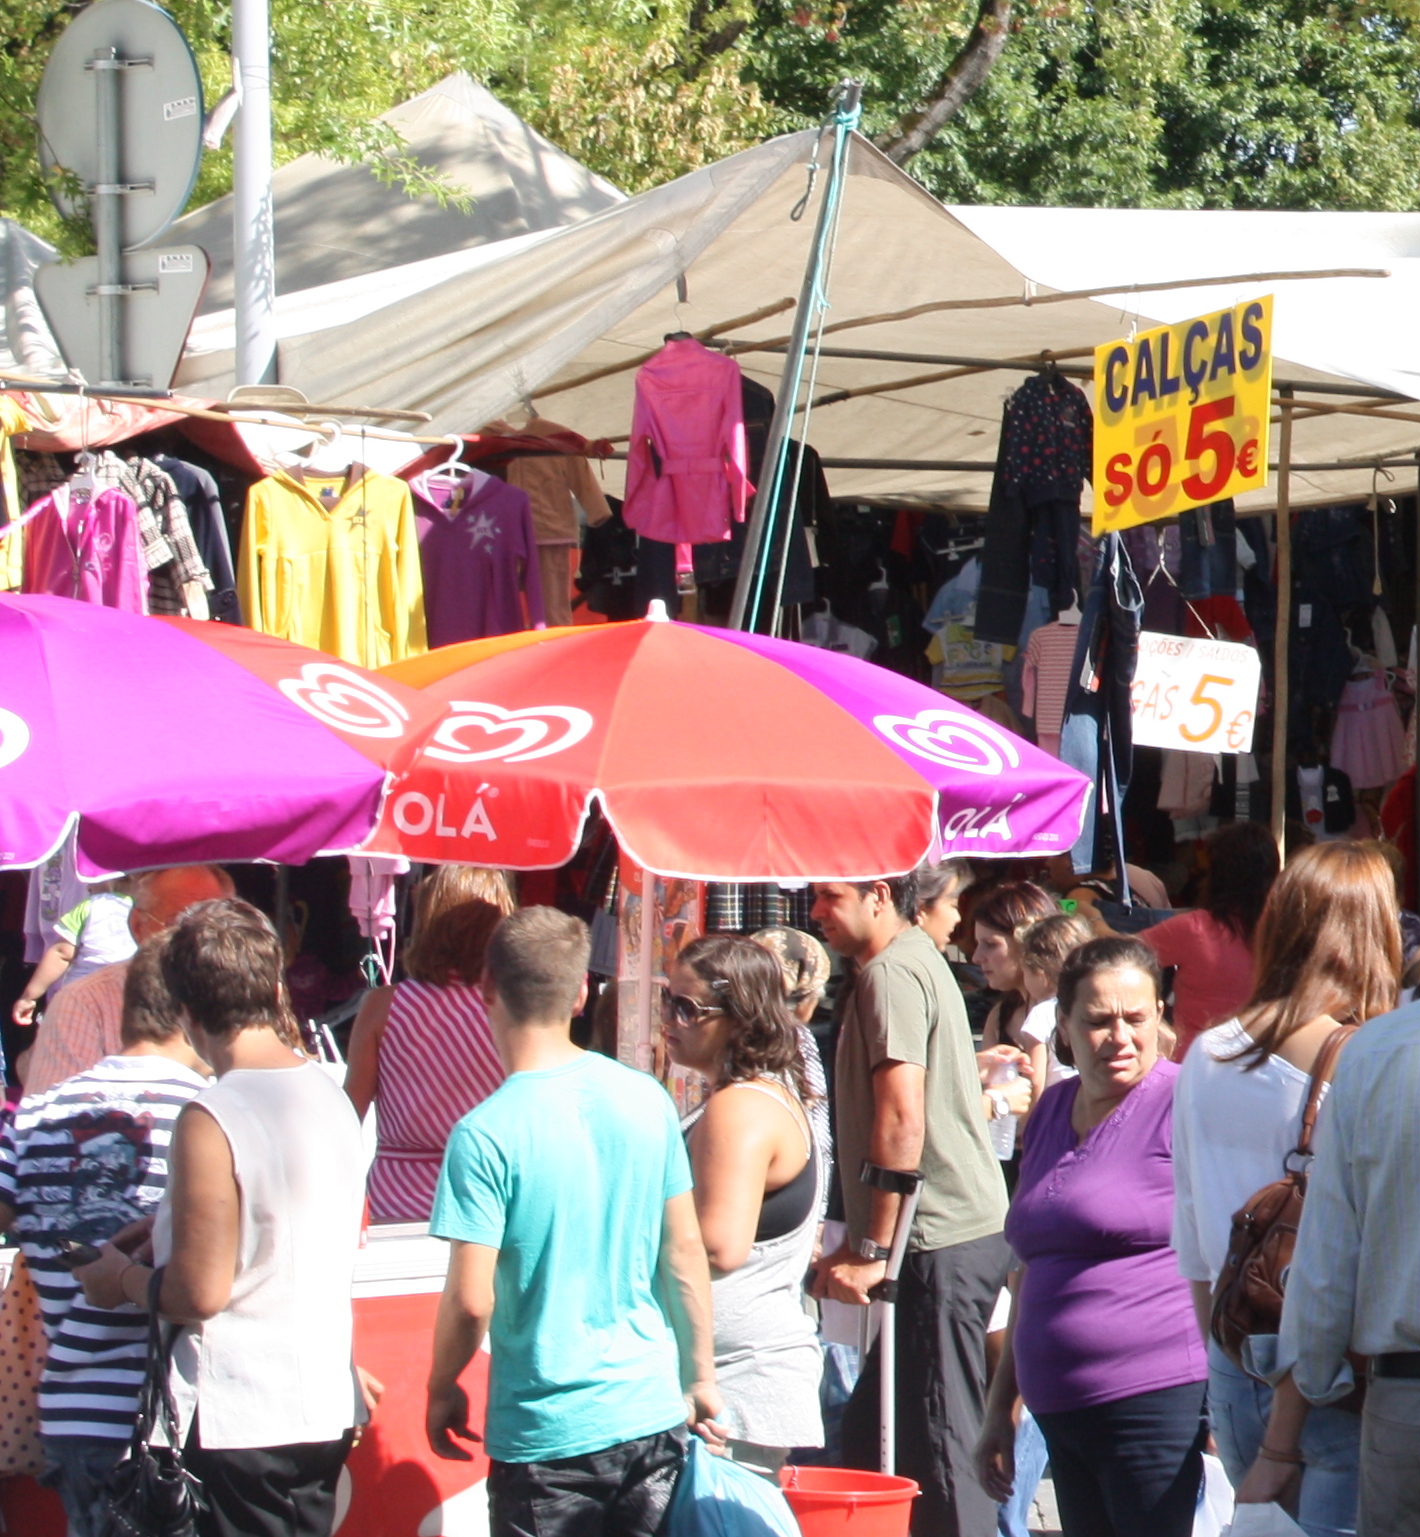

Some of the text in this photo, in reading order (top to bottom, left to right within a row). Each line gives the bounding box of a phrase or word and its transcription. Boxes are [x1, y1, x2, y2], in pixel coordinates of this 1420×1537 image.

[1105, 302, 1264, 413] CALÇAS
[393, 783, 498, 842] OLÁ
[944, 793, 1024, 841] OLÁ
